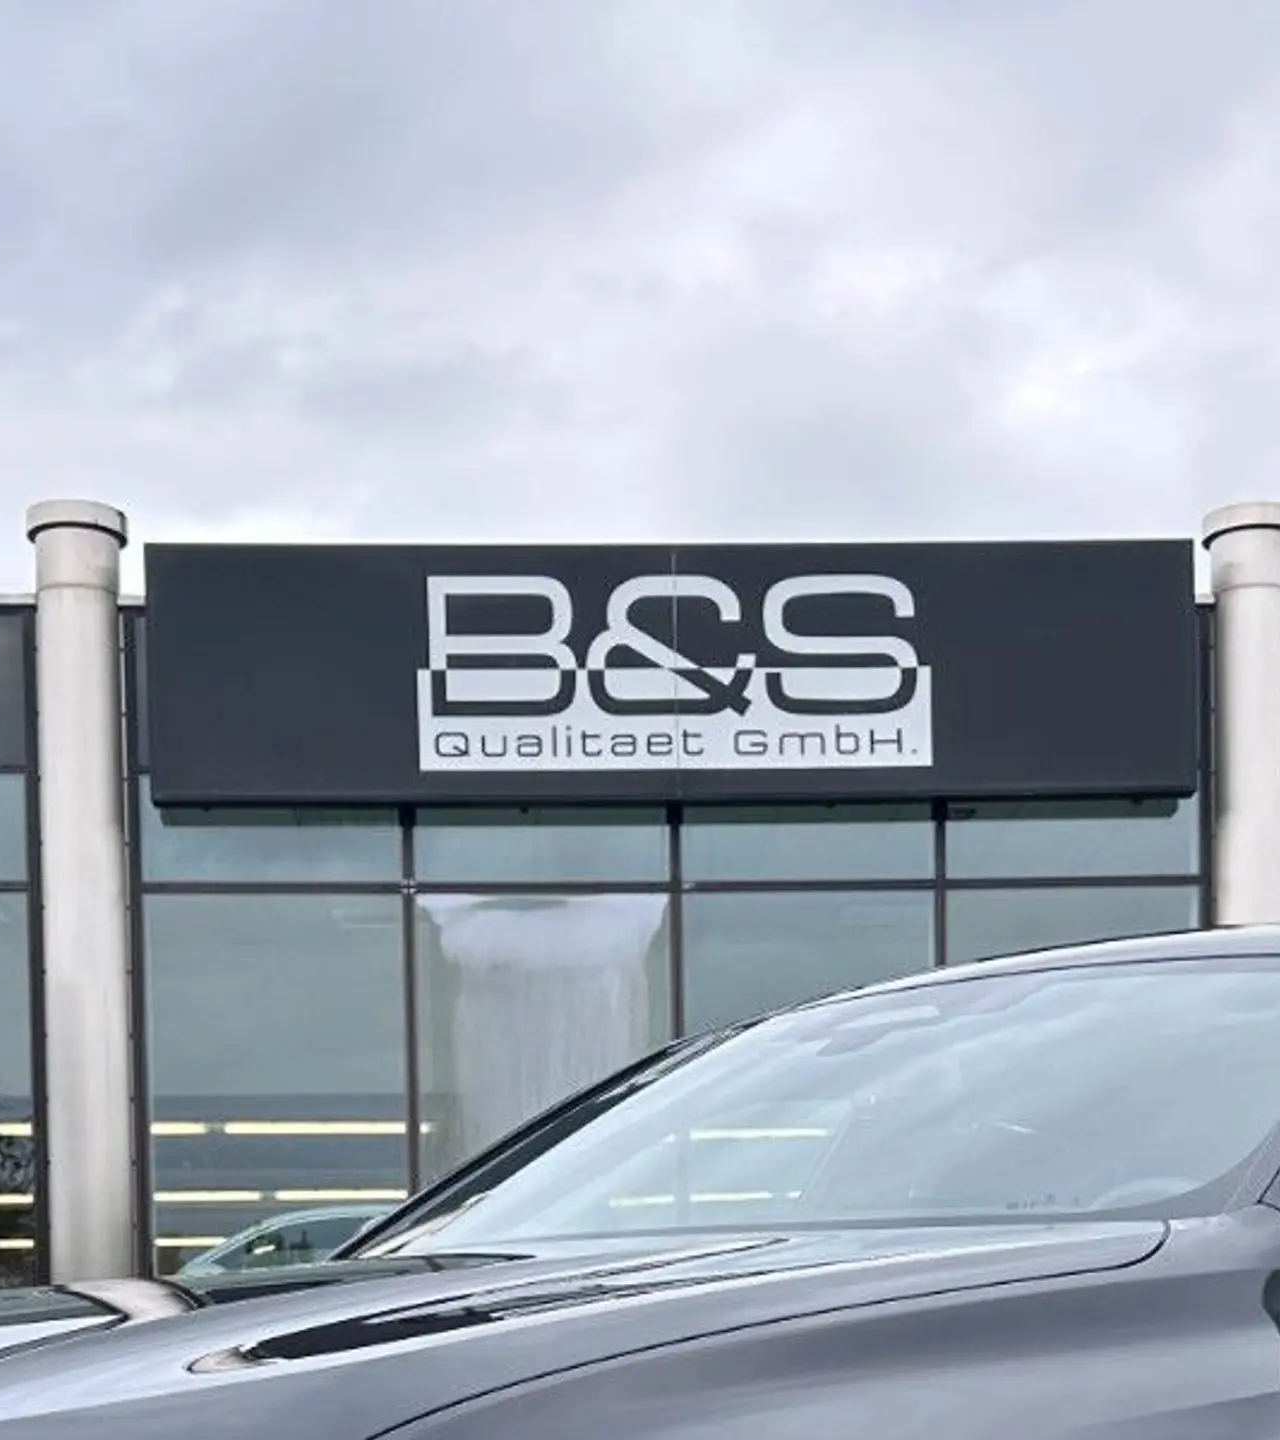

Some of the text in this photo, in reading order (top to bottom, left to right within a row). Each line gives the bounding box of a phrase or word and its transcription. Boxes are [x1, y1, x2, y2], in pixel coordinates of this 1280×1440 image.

[426, 574, 919, 717] B&S
[433, 724, 919, 759] Qualitaet GmbH.
